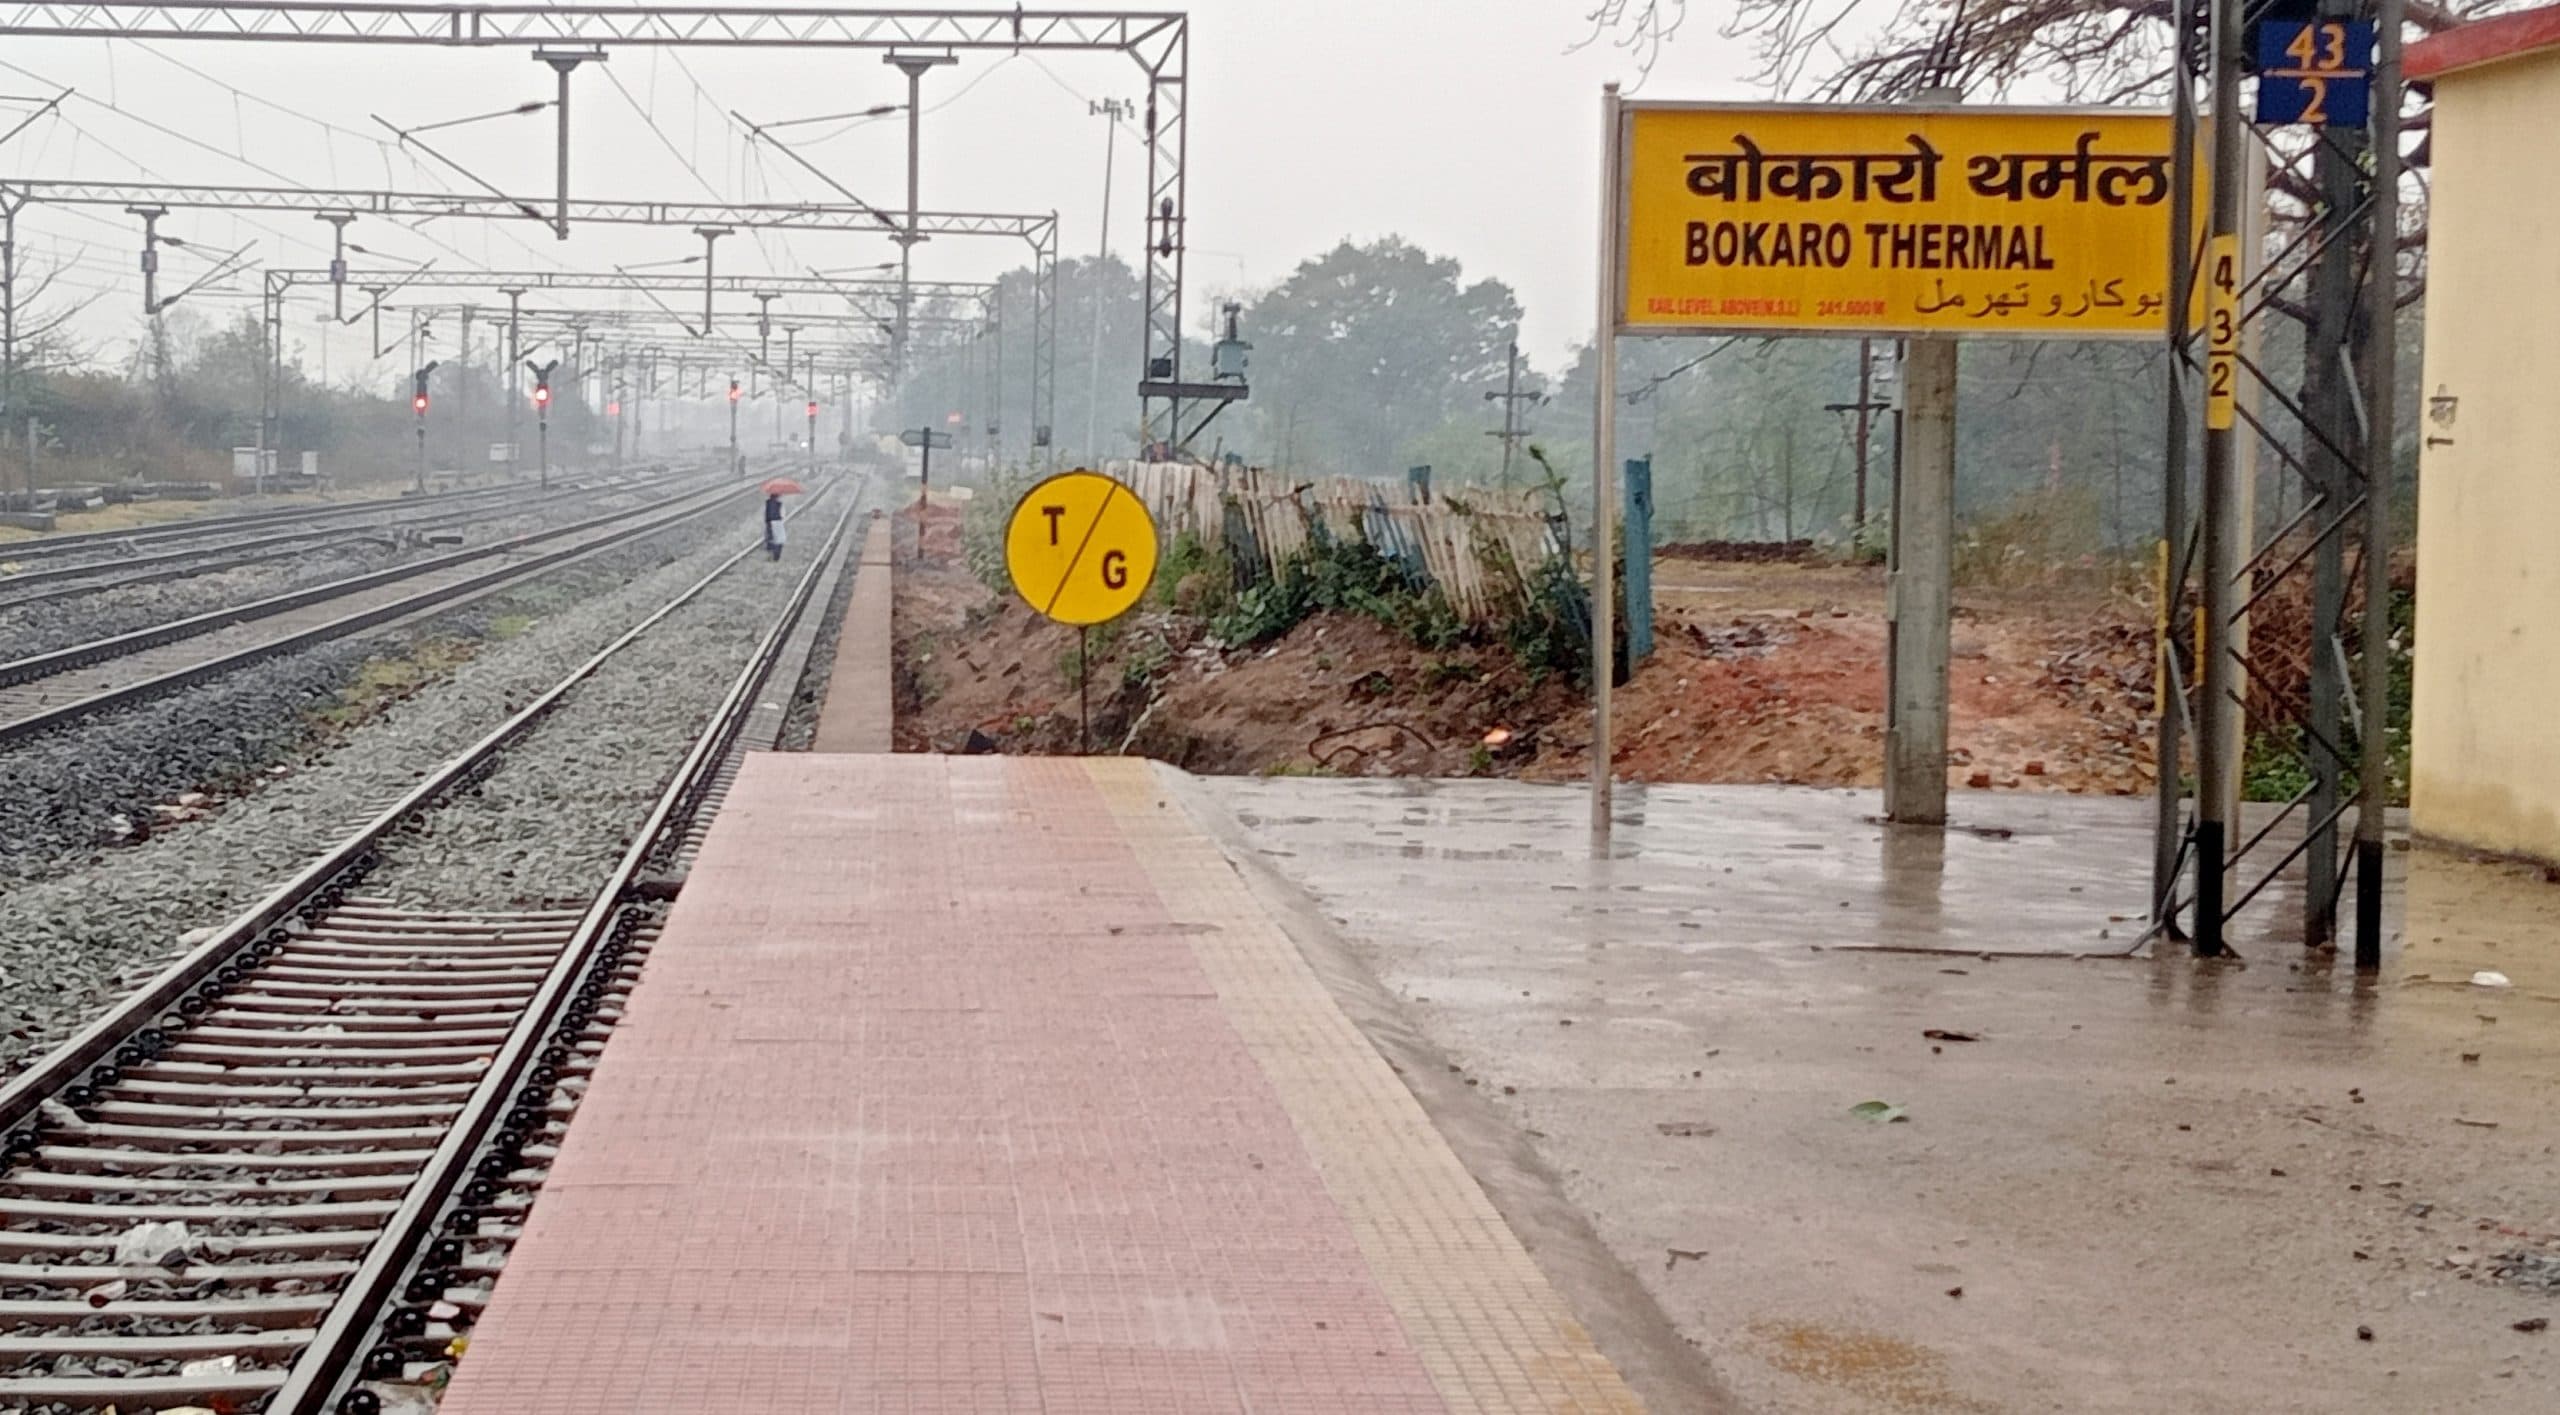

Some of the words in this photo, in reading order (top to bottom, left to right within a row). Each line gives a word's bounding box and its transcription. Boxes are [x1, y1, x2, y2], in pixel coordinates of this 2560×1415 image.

[2285, 23, 2345, 71] 43
[2299, 79, 2327, 123] 2
[1684, 133, 1944, 203] बोकारो
[1967, 131, 2170, 206] थर्मल
[1685, 221, 1851, 268] BOKARO
[1865, 223, 2054, 270] THERMAL
[1042, 505, 1067, 546] T
[1102, 550, 1128, 590] G
